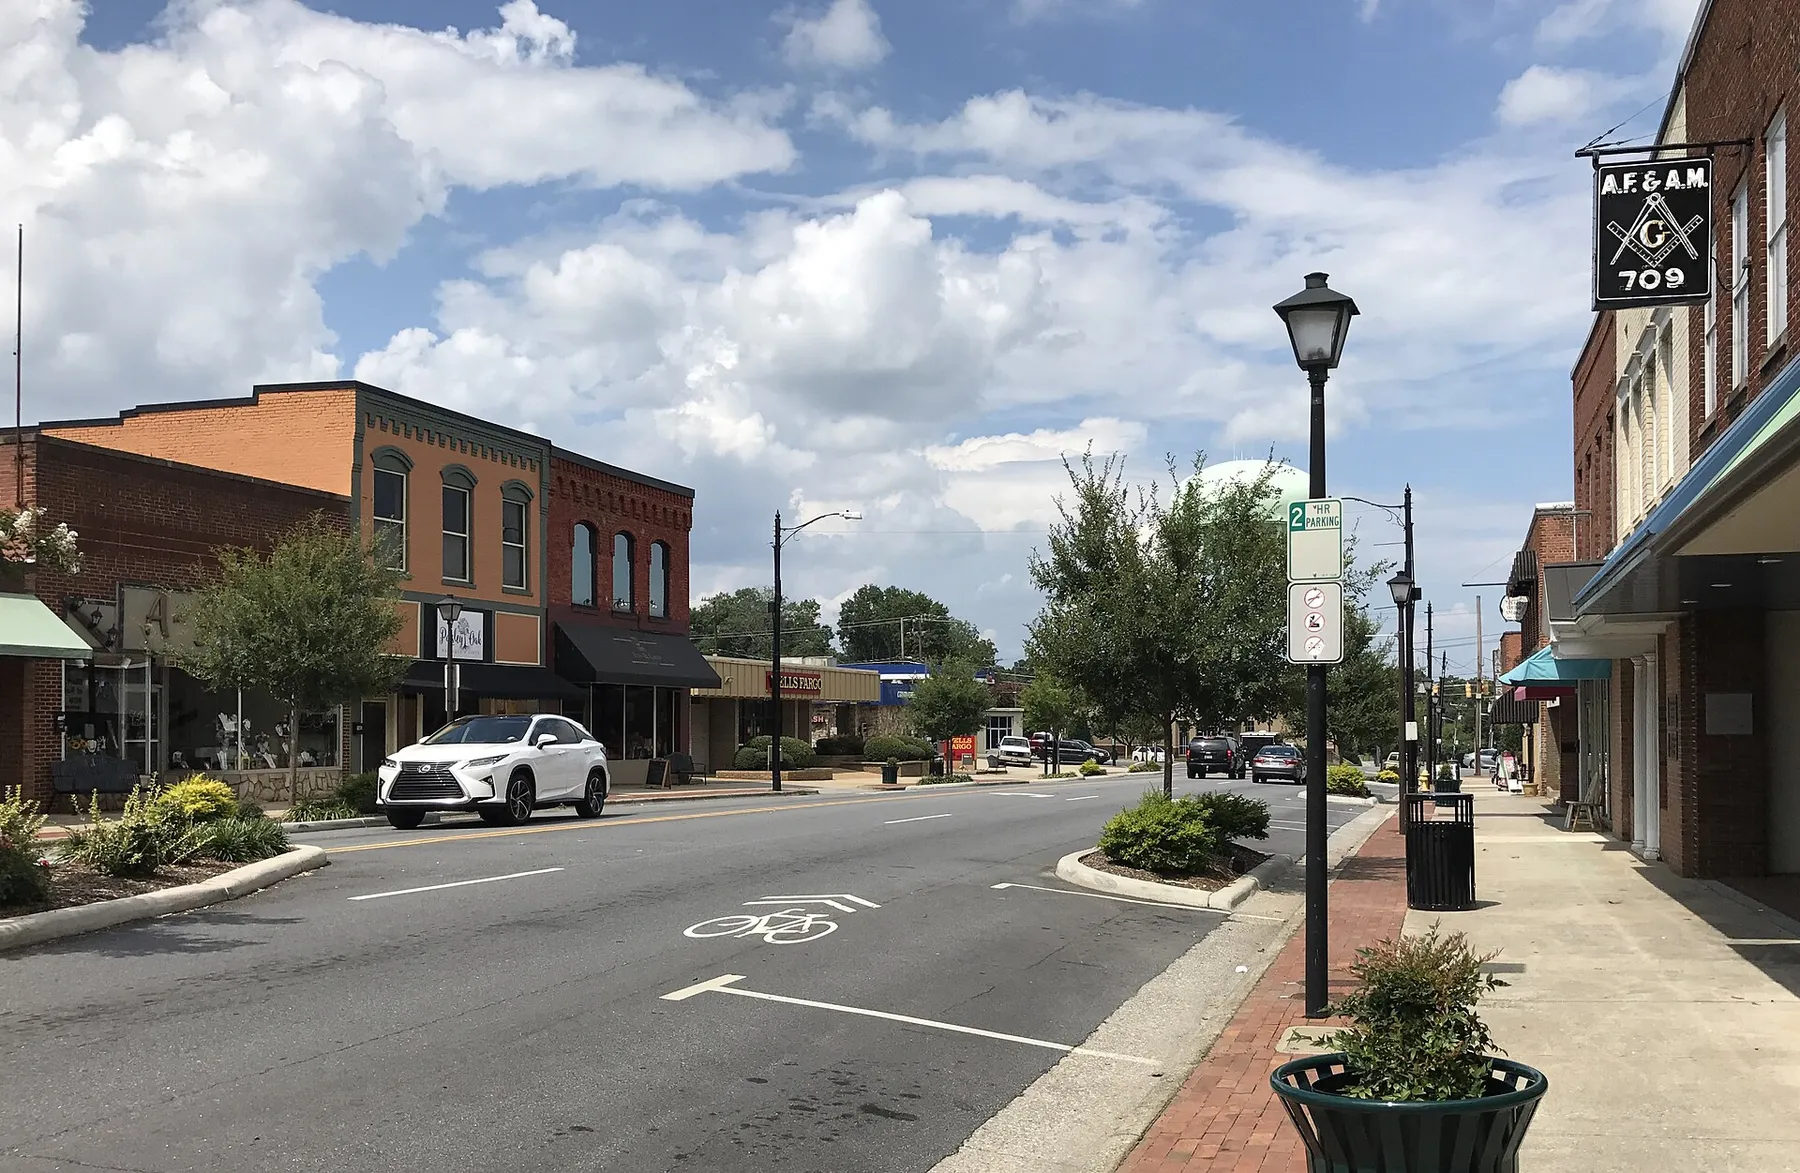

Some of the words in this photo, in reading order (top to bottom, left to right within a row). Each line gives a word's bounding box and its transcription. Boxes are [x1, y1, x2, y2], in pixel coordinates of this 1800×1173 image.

[1642, 170, 1662, 192] &
[1639, 219, 1672, 249] G
[1618, 267, 1685, 291] 709
[1291, 506, 1303, 527] 2
[1316, 503, 1331, 515] HR
[1306, 516, 1339, 528] PARKING
[770, 674, 798, 689] ELLS
[799, 677, 823, 690] FARGO
